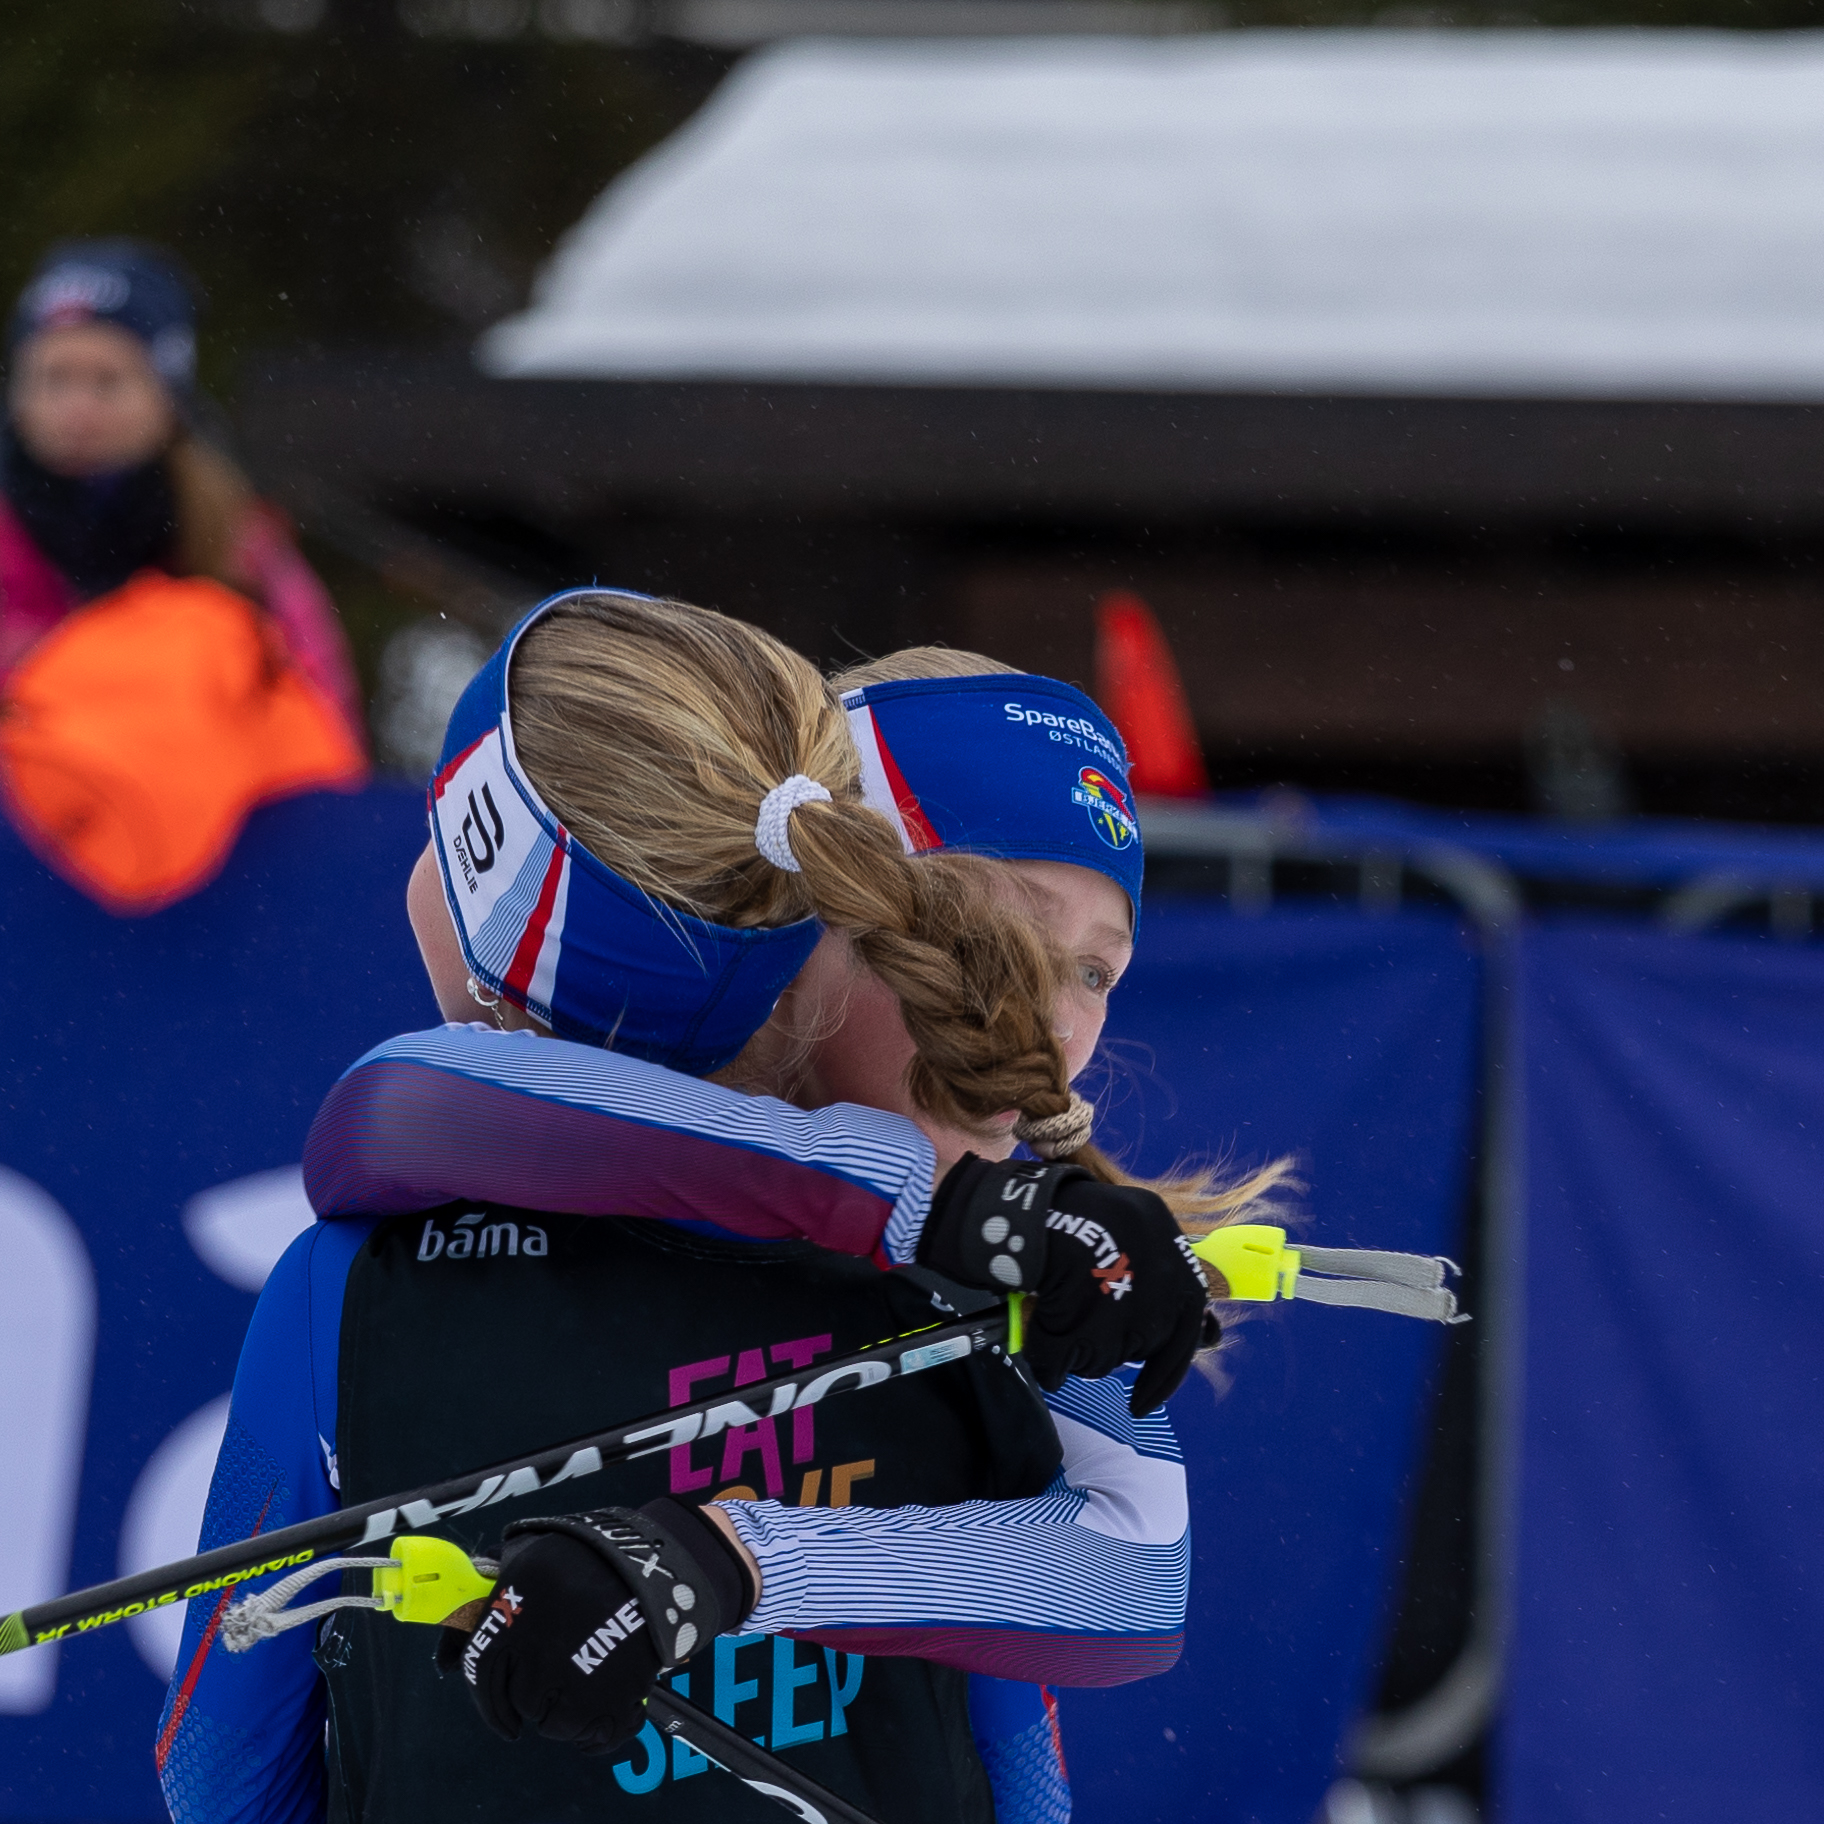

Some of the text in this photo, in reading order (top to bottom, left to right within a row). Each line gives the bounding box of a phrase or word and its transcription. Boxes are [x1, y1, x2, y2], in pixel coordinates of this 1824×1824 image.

[669, 1333, 833, 1498] EAT
[36, 1549, 315, 1645] DIAMOND STORM JR
